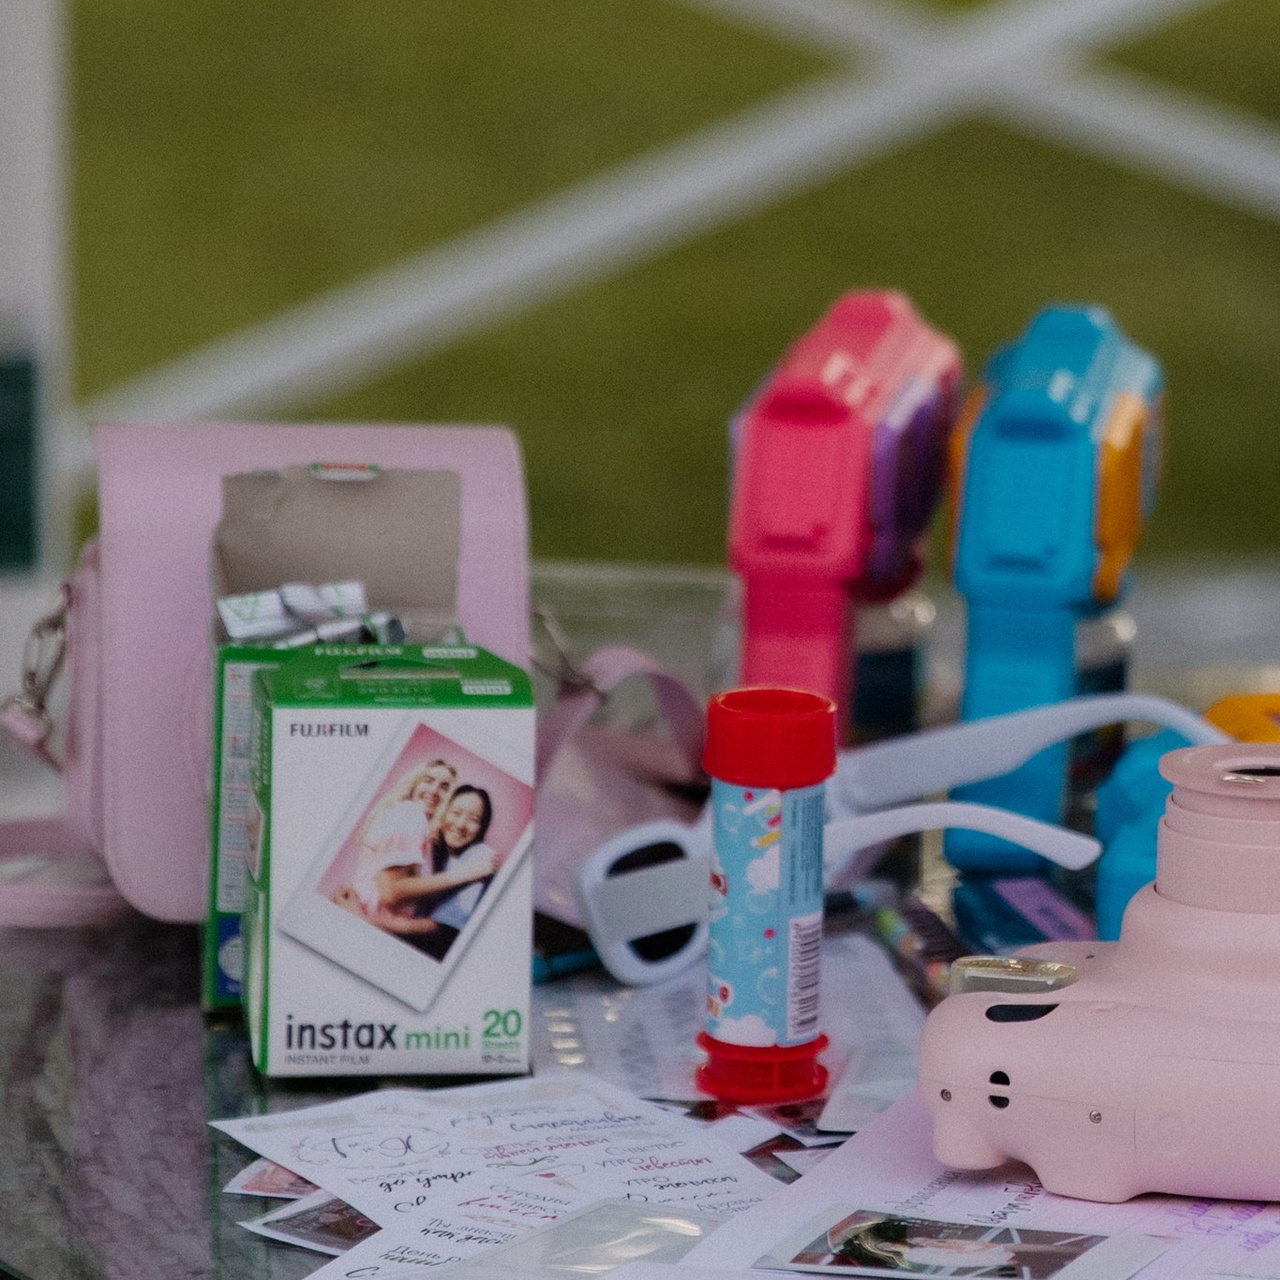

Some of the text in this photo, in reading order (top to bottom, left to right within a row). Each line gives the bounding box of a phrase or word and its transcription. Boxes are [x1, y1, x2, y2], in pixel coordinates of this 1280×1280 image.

[289, 722, 370, 738] FUJIFILM
[285, 1008, 523, 1052] instax mini 20
[284, 1054, 371, 1066] INSTANT FILM
